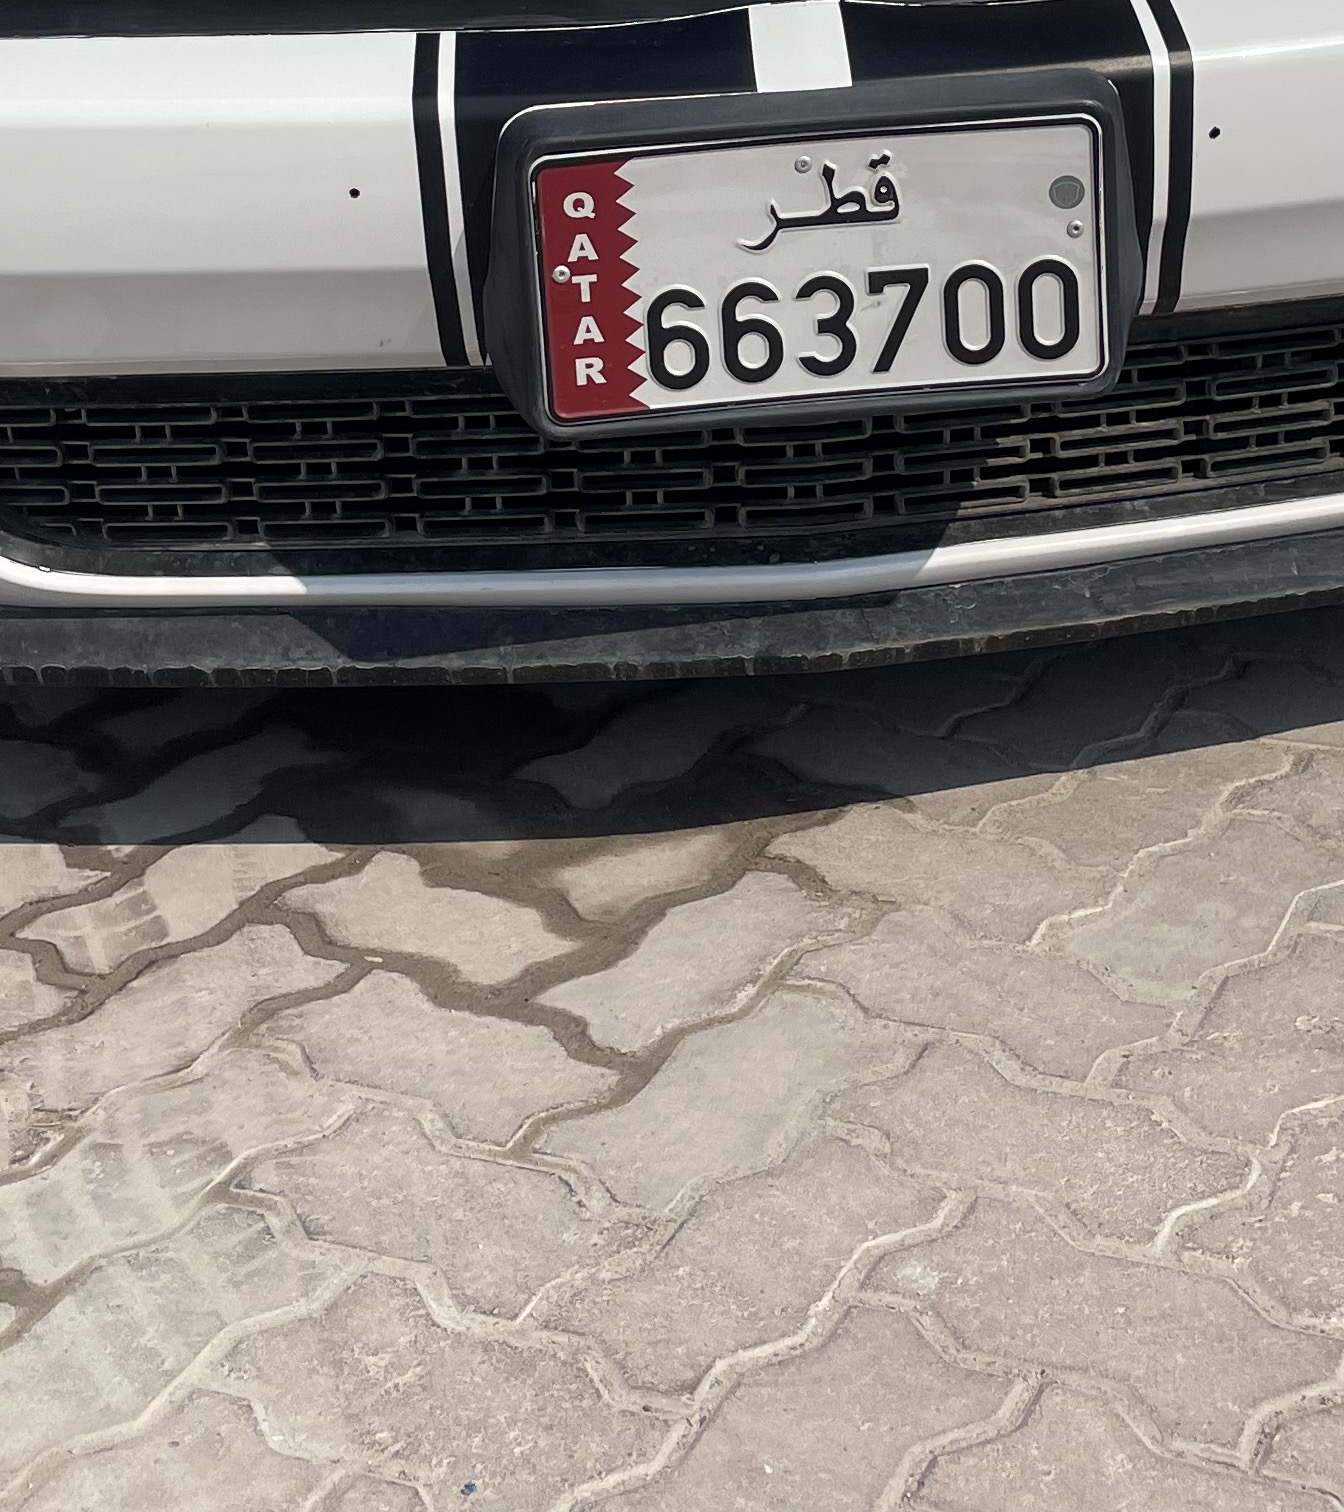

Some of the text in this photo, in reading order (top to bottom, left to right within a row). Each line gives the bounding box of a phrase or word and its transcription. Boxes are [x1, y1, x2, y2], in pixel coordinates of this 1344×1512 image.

[737, 150, 901, 254] قطر
[562, 191, 607, 386] QATAR
[646, 256, 1080, 390] 663700
